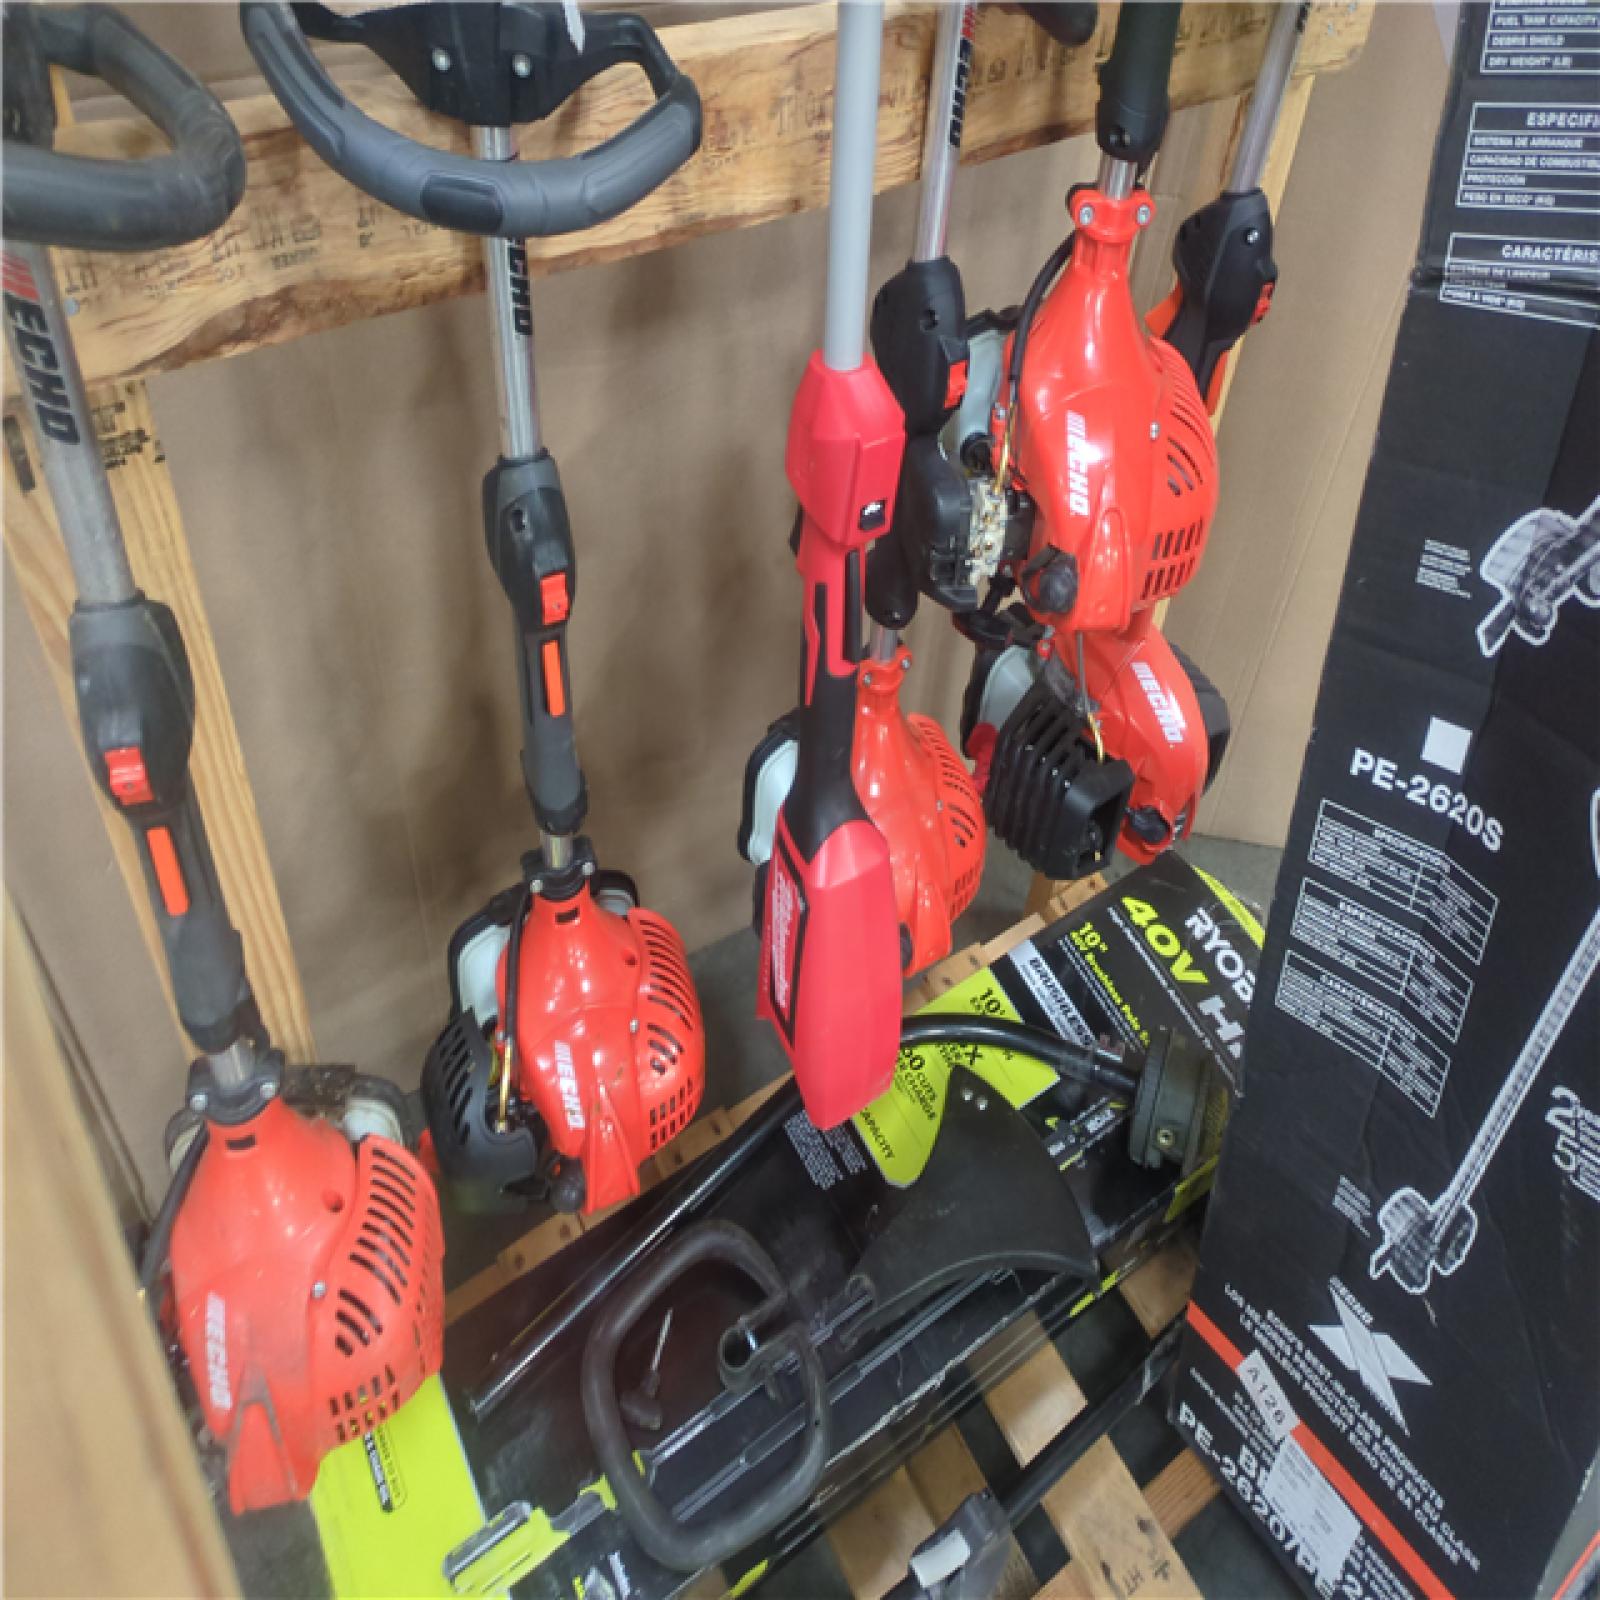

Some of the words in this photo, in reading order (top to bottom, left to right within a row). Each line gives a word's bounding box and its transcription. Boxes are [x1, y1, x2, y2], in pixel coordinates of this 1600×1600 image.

[8, 300, 80, 446] ECHO
[1350, 746, 1504, 853] PE-2620S
[1121, 895, 1209, 984] 40V
